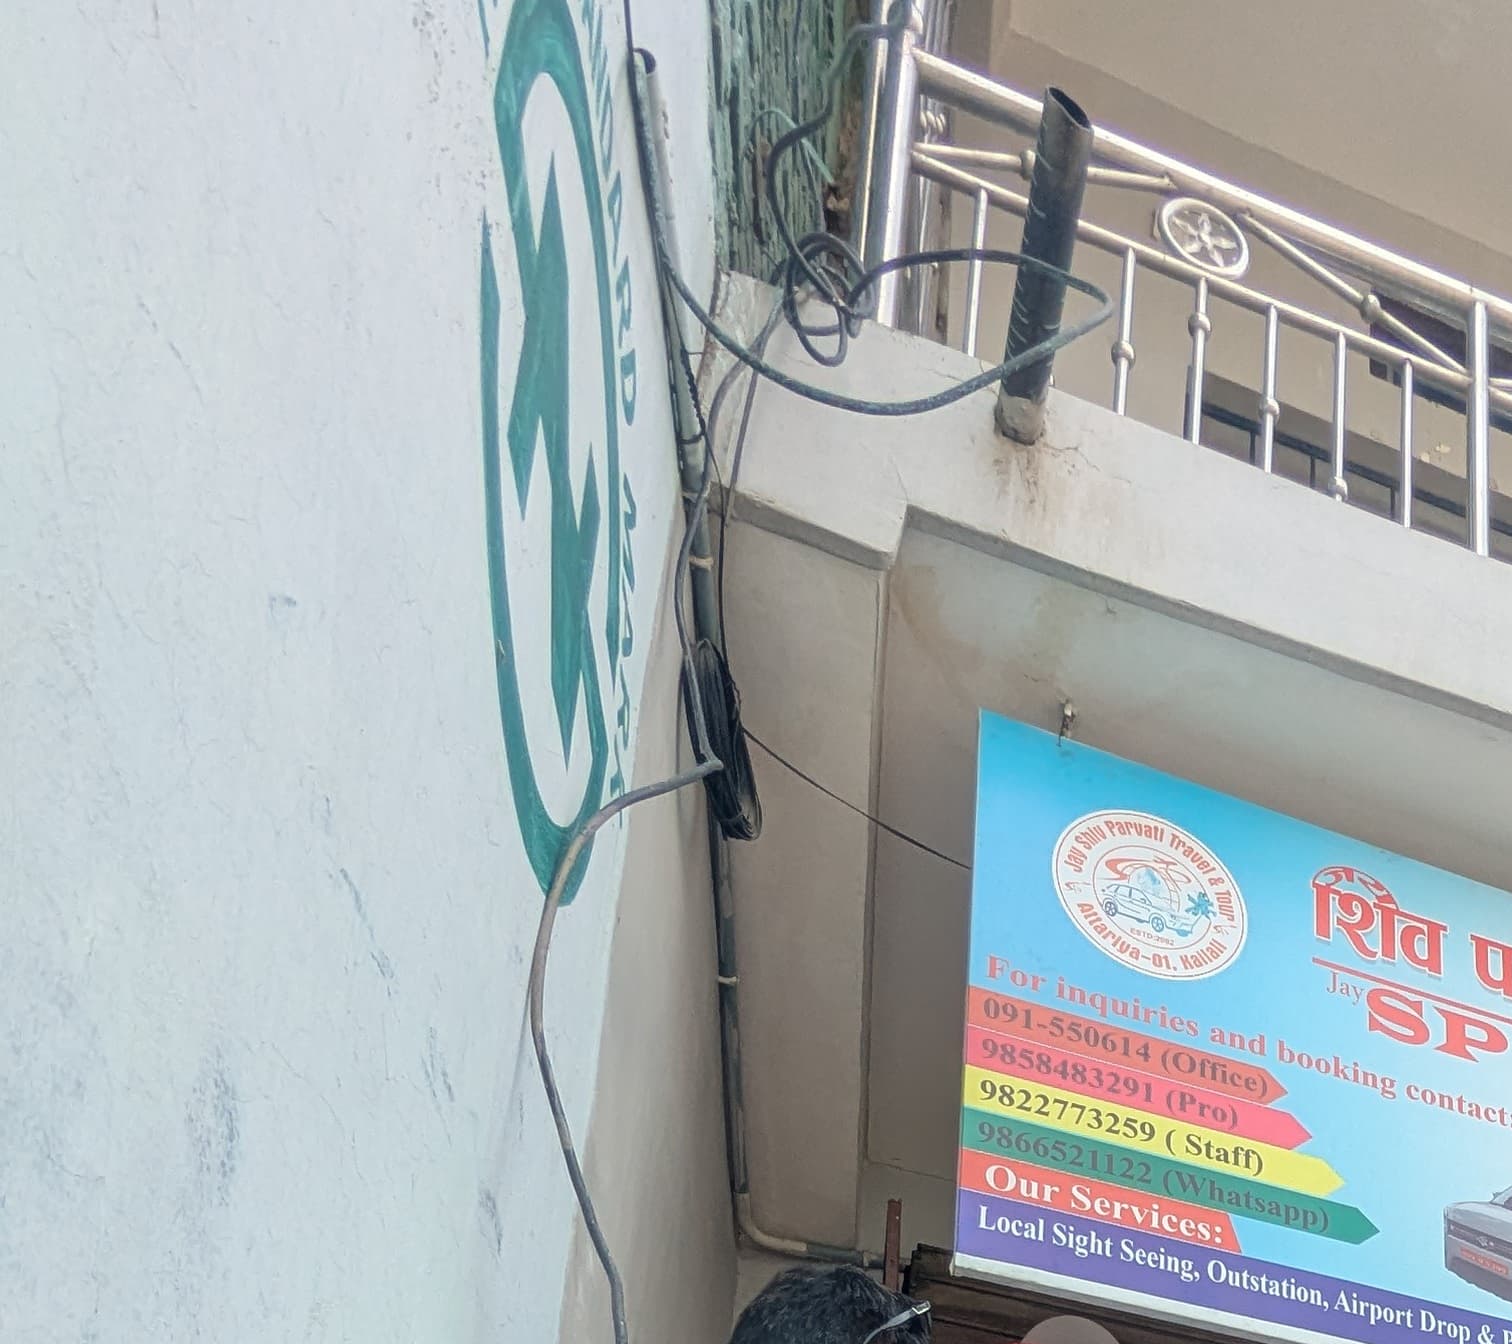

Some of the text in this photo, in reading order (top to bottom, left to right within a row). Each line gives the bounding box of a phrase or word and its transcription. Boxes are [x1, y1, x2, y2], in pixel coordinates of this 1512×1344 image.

[1169, 832, 1216, 880] Travel
[1207, 876, 1225, 888] &
[1214, 889, 1235, 922] Tour
[1312, 880, 1447, 976] शिव
[986, 955, 1047, 992] For
[1056, 976, 1199, 1037] inquiries
[1210, 1026, 1267, 1057] and
[1277, 1039, 1396, 1100] booking
[1327, 972, 1364, 1006] Jay
[982, 1038, 1238, 1130] 9858483291 (Pro)
[983, 998, 1268, 1098] 091-550614 (Office)
[979, 1079, 1155, 1143] 9822773259
[979, 1121, 1329, 1233] 9866521122 (Whatsapp)
[985, 1164, 1223, 1245] Our Services:
[979, 1205, 1044, 1242] Local
[1052, 1219, 1112, 1257] Sight
[1120, 1239, 1201, 1282] Seeing,
[1207, 1258, 1330, 1312] Outstation,
[1334, 1290, 1413, 1329] Airport
